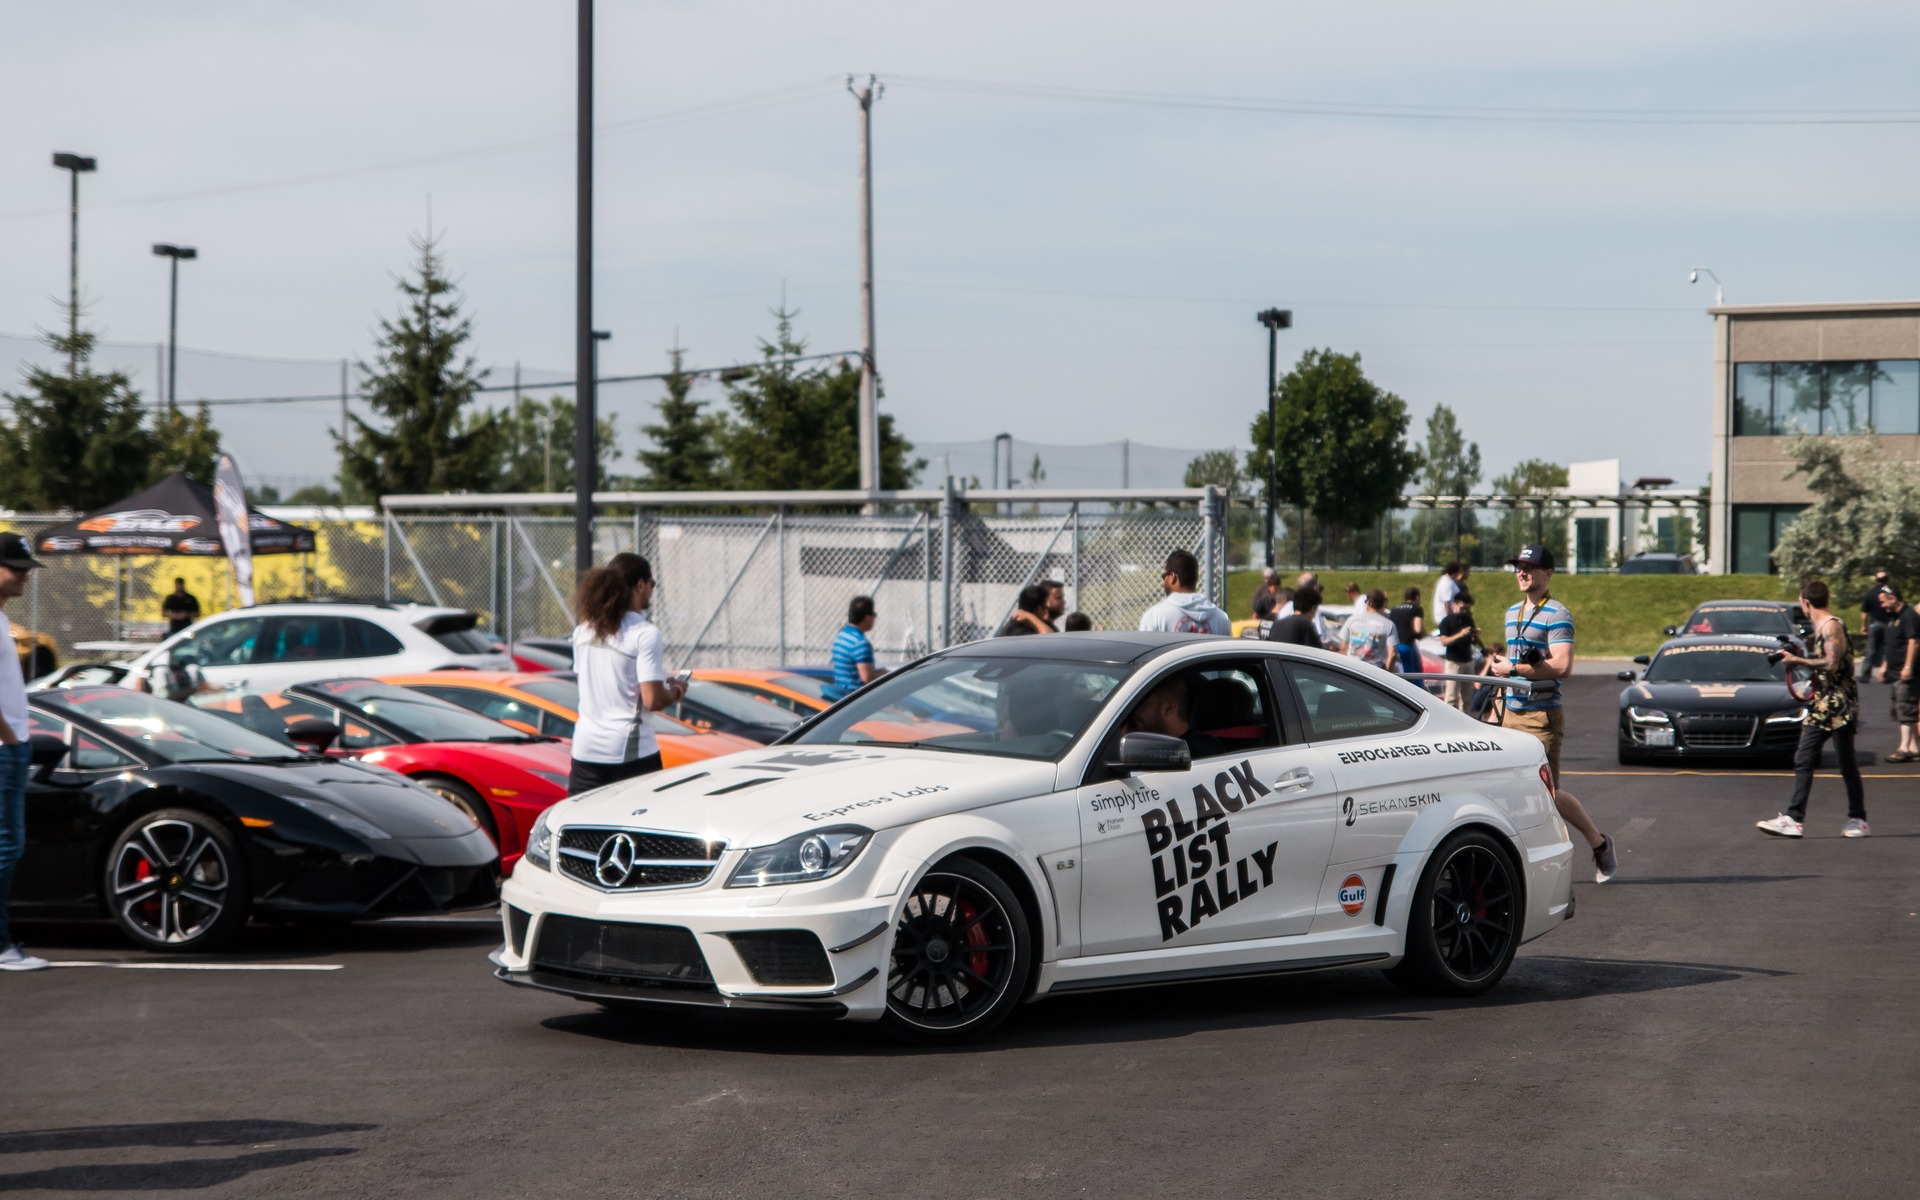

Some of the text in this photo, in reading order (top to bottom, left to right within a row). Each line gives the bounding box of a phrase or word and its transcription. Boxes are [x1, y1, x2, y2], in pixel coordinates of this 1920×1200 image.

[1338, 741, 1503, 764] EUROCHARGED CANADA
[803, 784, 949, 822] Espress Labs
[1091, 787, 1160, 813] simplytire
[1141, 759, 1271, 856] BLACK
[1360, 792, 1441, 815] SEKANSKIN
[1152, 820, 1231, 899] LIST
[1157, 840, 1278, 942] RALLY
[1340, 889, 1365, 902] Gulf
